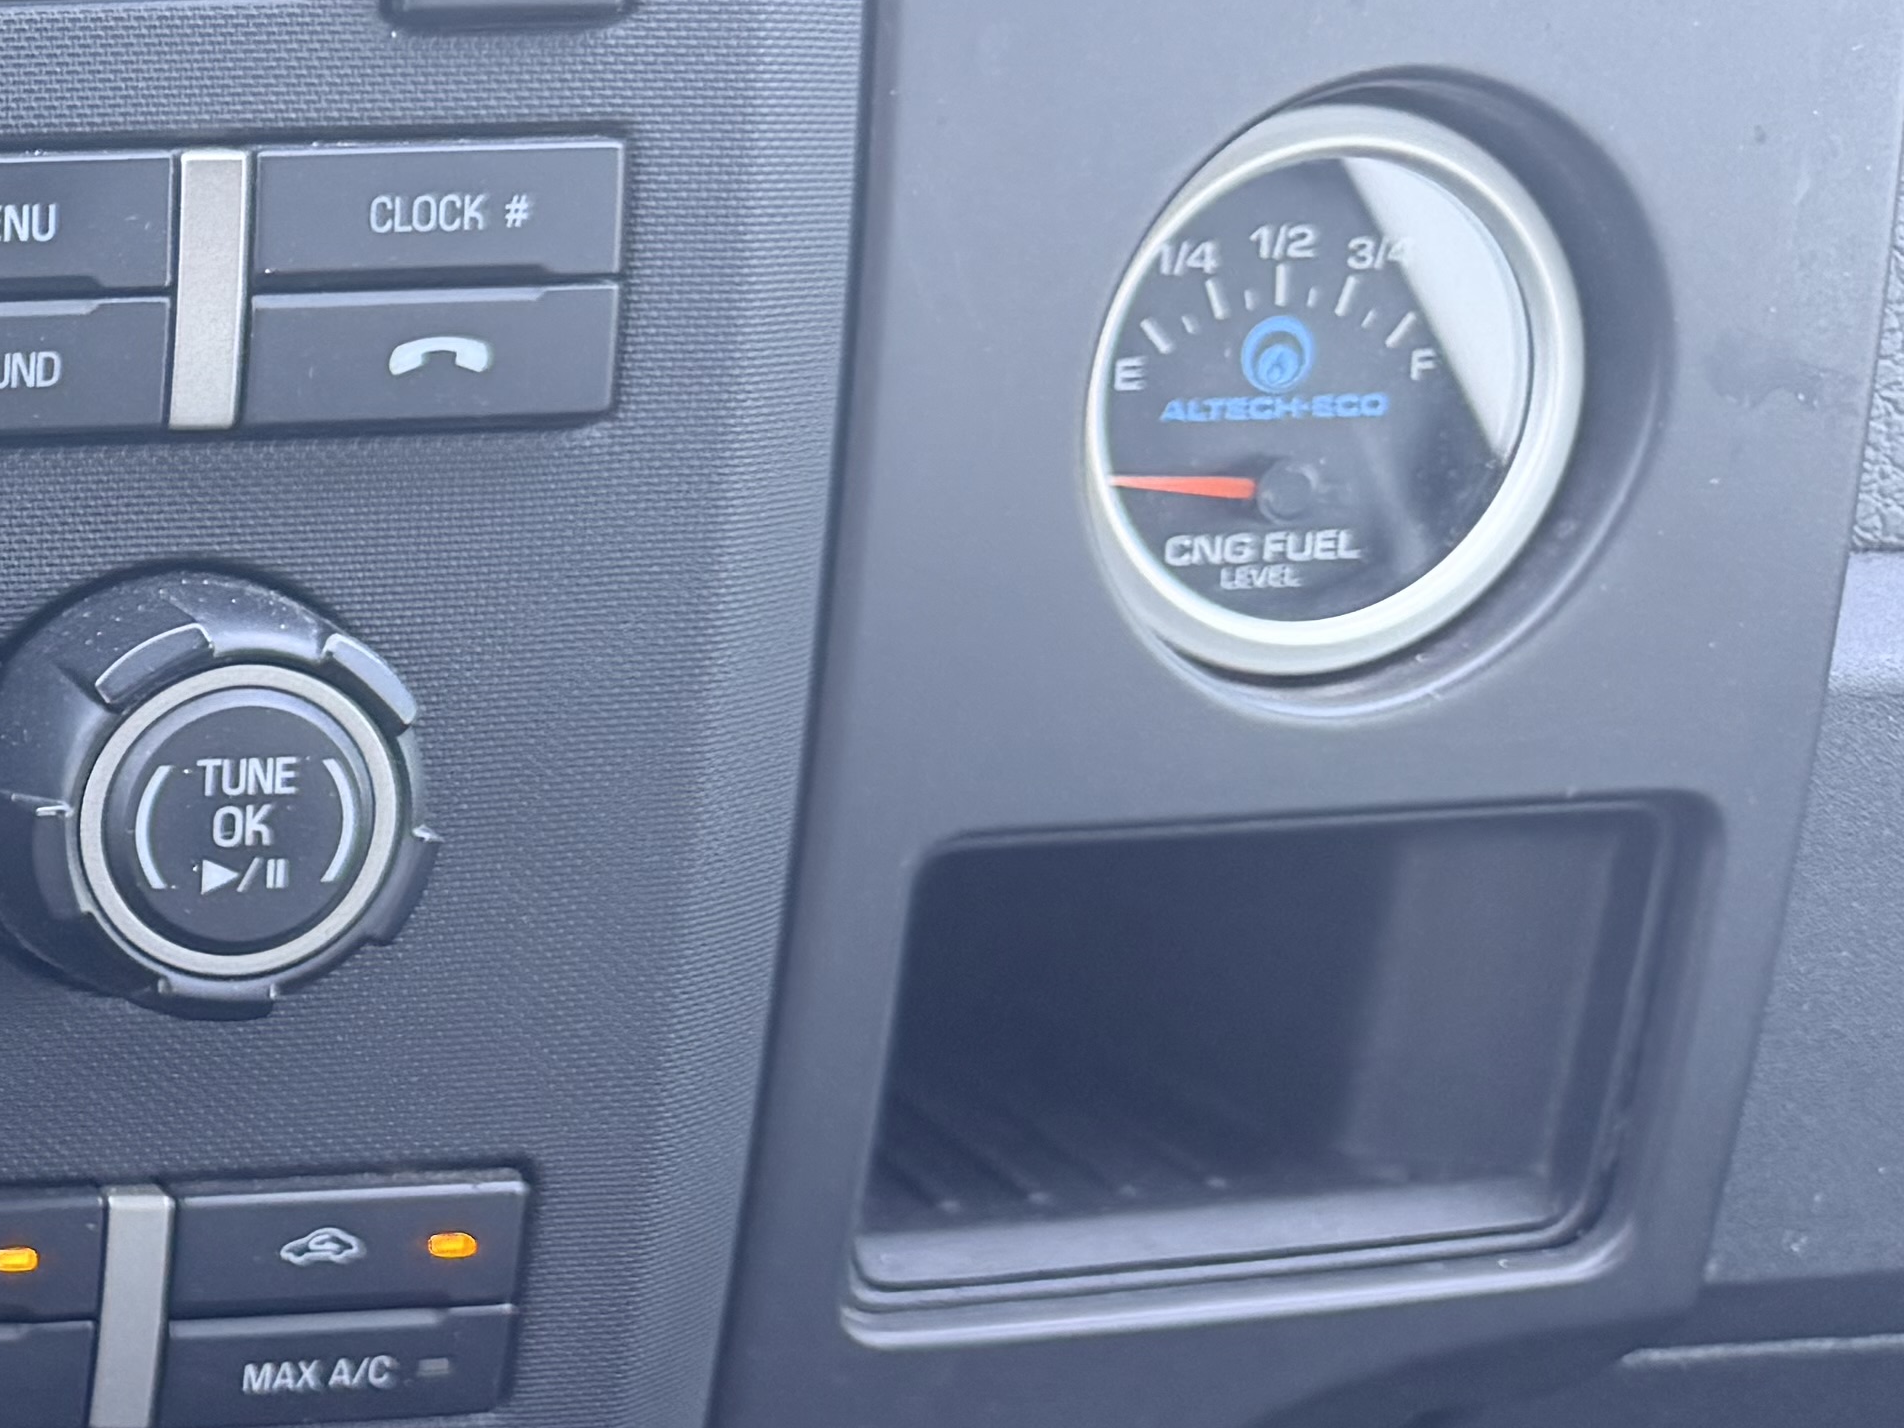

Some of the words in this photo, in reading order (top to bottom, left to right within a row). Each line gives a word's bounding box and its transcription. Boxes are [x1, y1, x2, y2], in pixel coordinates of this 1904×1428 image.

[370, 193, 486, 234] CLOCK
[504, 194, 532, 229] #
[1156, 241, 1220, 276] 1/4
[1249, 225, 1319, 261] 1/2
[1346, 237, 1411, 270] 3/4
[1113, 357, 1149, 392] E
[1410, 350, 1438, 382] F
[1164, 533, 1256, 568] CNG
[1261, 528, 1363, 563] FUEL
[1219, 566, 1304, 591] LEVEL
[196, 756, 300, 797] TUNE
[212, 804, 274, 848] OK
[242, 1359, 321, 1393] MAX
[328, 1354, 397, 1388] A/C
